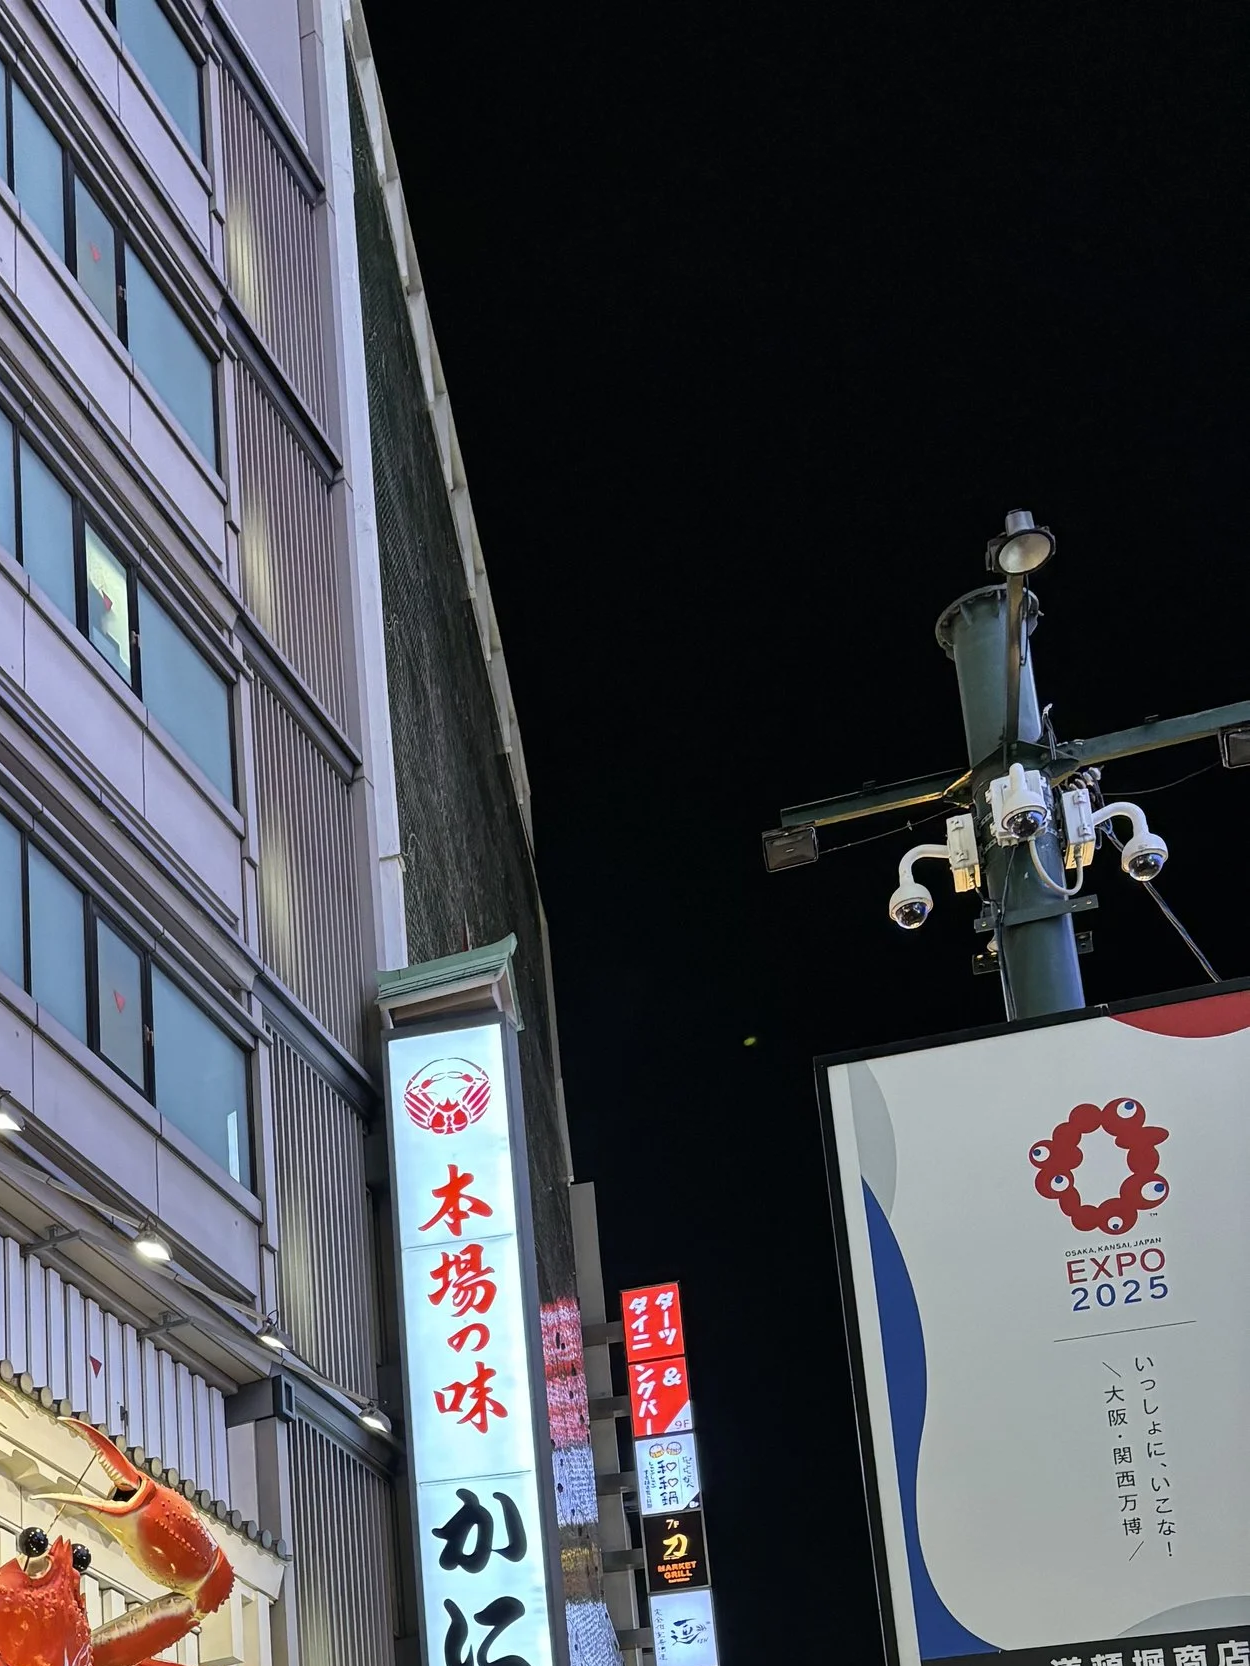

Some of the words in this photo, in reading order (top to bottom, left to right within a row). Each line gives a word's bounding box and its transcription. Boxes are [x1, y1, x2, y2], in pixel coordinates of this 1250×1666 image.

[1065, 1247, 1097, 1257] OSAKA,
[1134, 1237, 1162, 1247] JAPAN
[1066, 1248, 1166, 1285] EXPO
[418, 1163, 509, 1434] 本場の味
[1071, 1275, 1168, 1311] 2025
[1103, 1384, 1143, 1536] 大阪・関西万博
[665, 1518, 680, 1530] 7F
